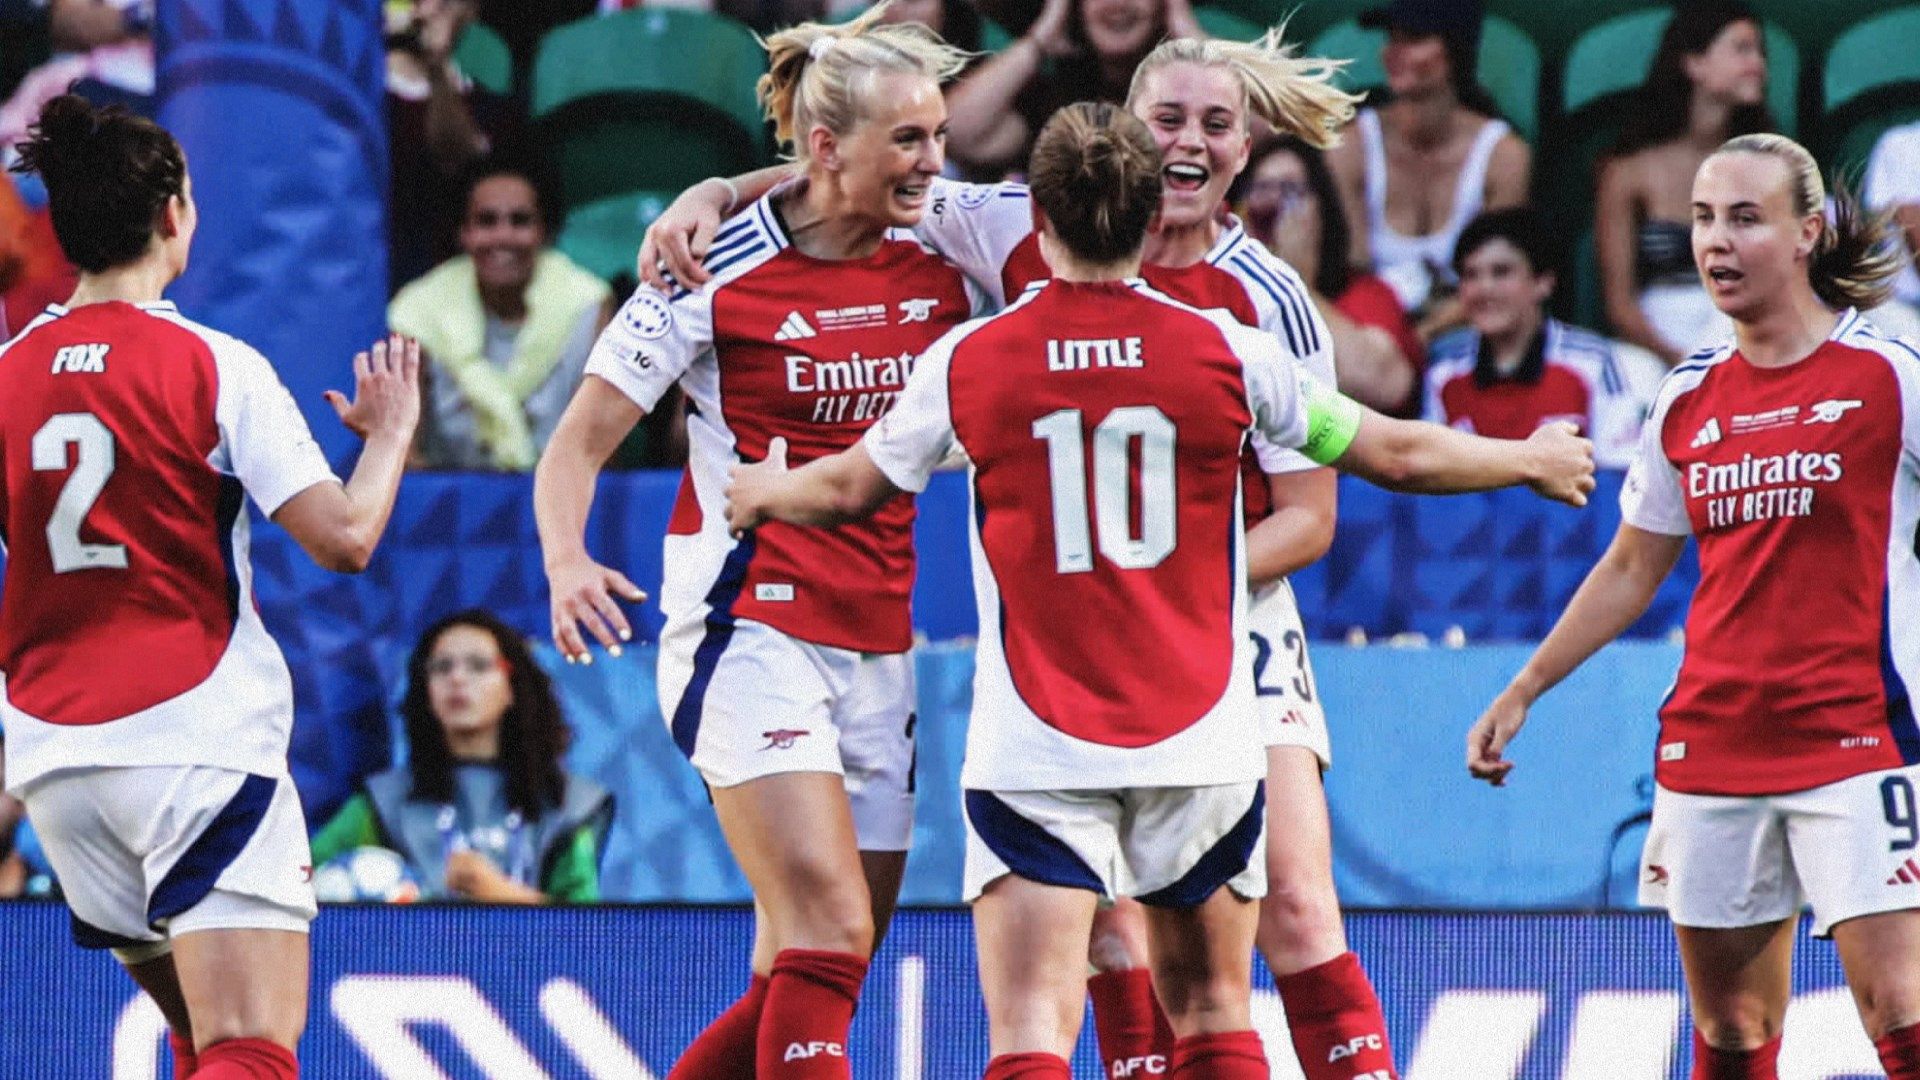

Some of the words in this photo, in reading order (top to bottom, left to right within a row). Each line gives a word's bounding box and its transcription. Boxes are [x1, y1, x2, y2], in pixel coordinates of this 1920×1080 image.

[51, 343, 110, 375] FOX
[784, 352, 914, 392] Emirat
[1047, 337, 1144, 372] LITTLE
[812, 394, 850, 422] FLY
[32, 412, 128, 574] 2
[1032, 405, 1177, 573] 10
[1688, 450, 1843, 498] Emirates
[1707, 495, 1738, 529] FLY
[1742, 487, 1815, 523] BETTER
[1249, 629, 1312, 703] 23
[1880, 775, 1919, 852] 9
[784, 1041, 843, 1062] AFC
[1112, 1054, 1167, 1079] AFC
[1328, 1033, 1382, 1063] AFC
